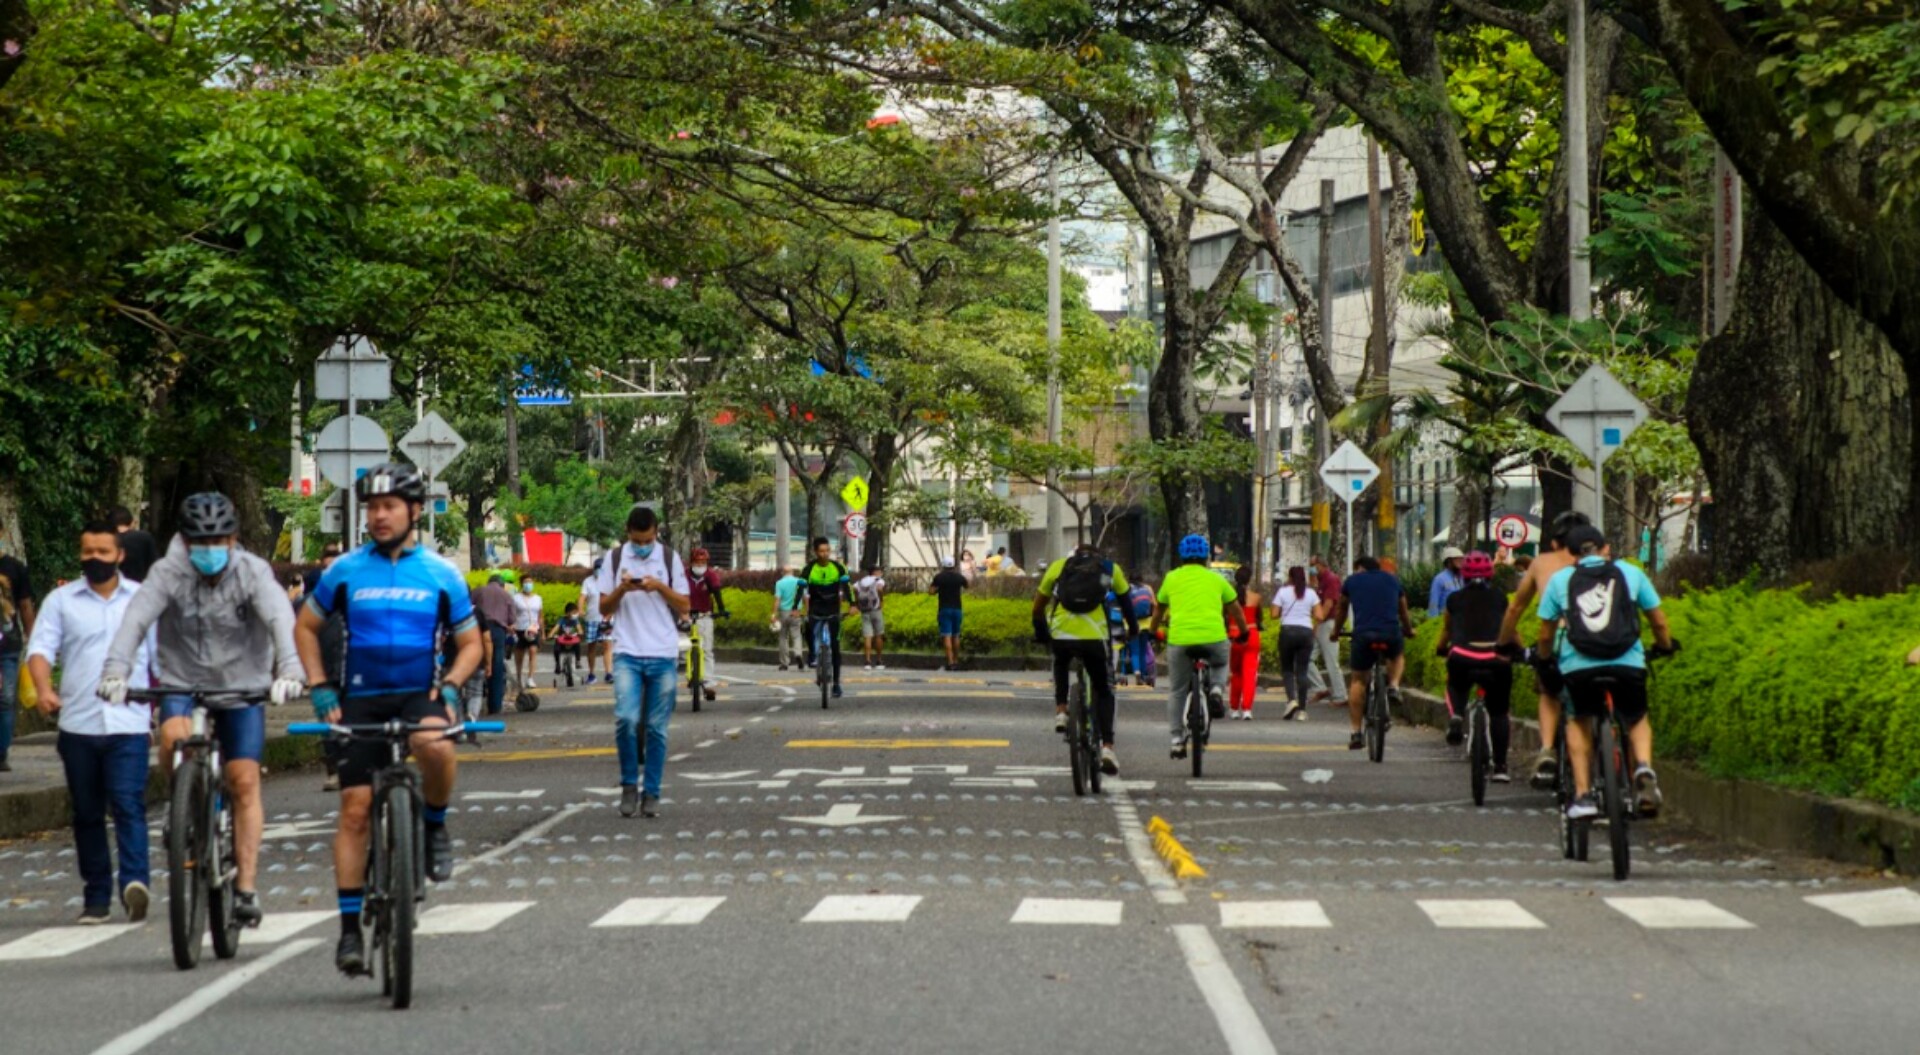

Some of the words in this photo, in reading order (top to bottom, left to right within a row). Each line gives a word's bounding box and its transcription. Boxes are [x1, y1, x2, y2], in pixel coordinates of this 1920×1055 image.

[849, 518, 866, 532] 30
[353, 586, 433, 602] GIANT
[677, 765, 1074, 780] ZONA
